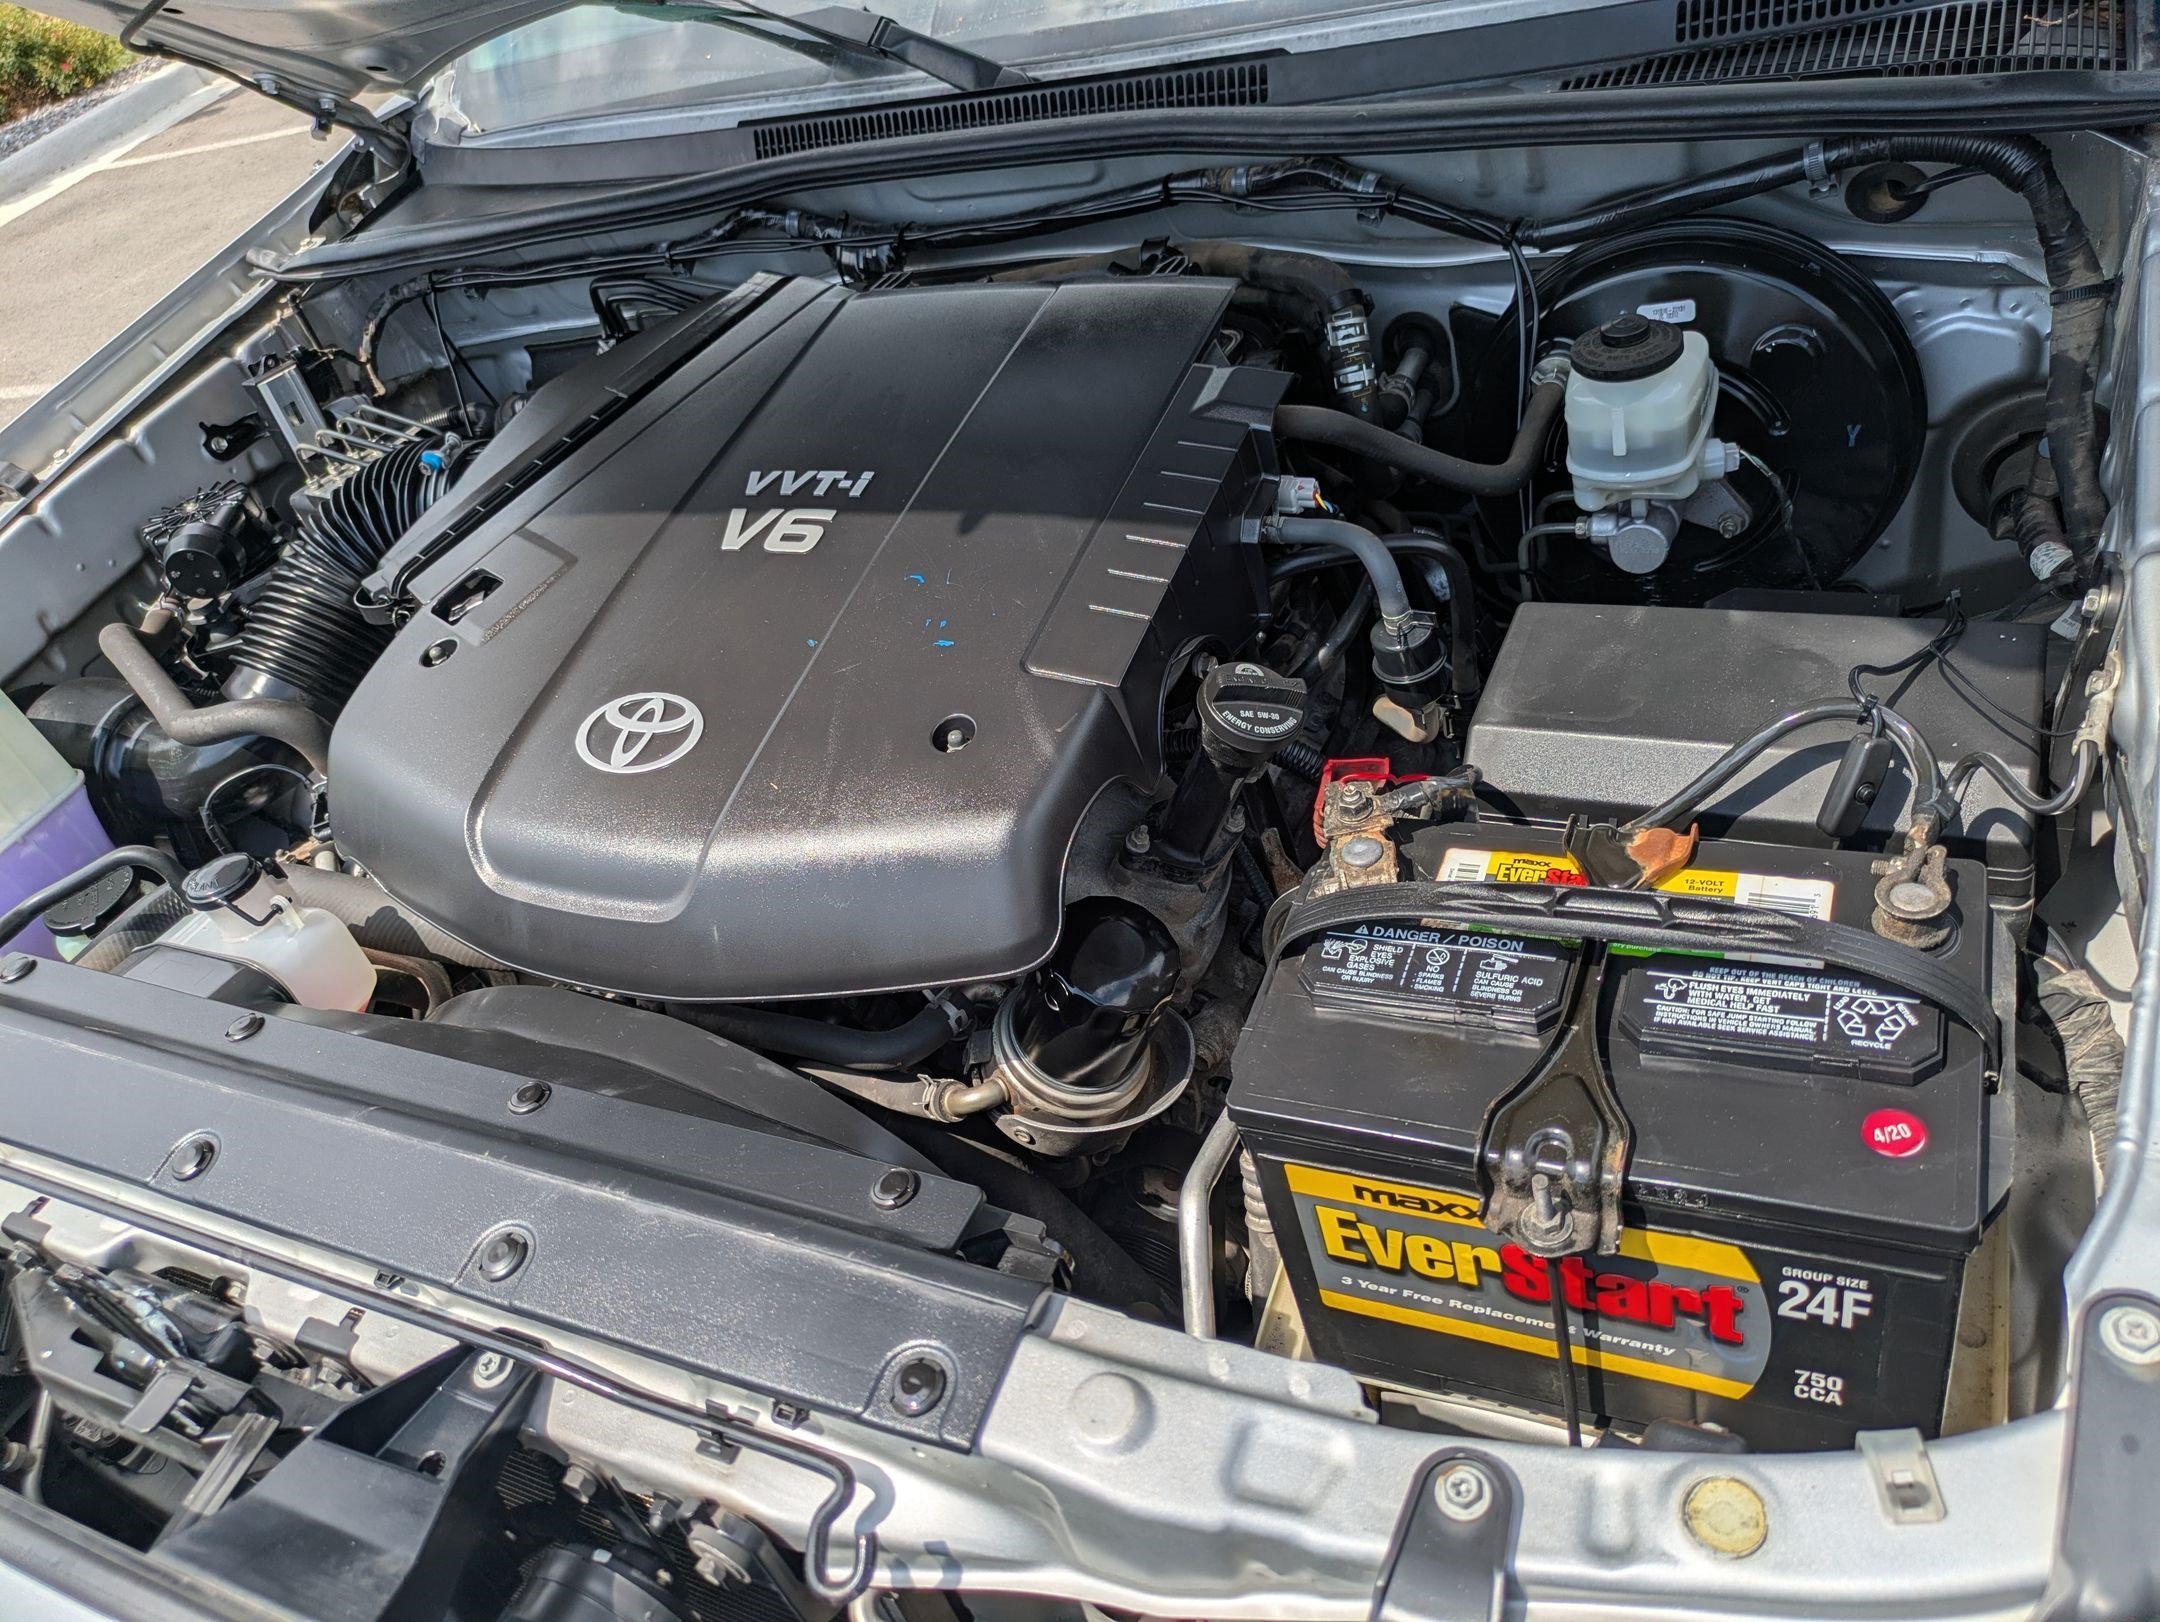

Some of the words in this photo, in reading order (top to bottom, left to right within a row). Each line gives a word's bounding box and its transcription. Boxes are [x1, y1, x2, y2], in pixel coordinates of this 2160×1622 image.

[745, 470, 875, 498] VVT-i
[721, 508, 837, 554] V6
[1222, 710, 1253, 731] ENERGY
[1254, 716, 1297, 735] CONSERVING
[1240, 710, 1254, 718] SAE
[1257, 711, 1280, 721] 5W-30
[1513, 859, 1552, 867] maxx
[1495, 863, 1589, 888] EverSta
[1684, 878, 1725, 887] 12-VOLT
[1688, 885, 1724, 894] Battery
[1372, 926, 1440, 943] DANGER
[1458, 935, 1524, 952] POISON
[1371, 951, 1393, 959] EYES
[1373, 944, 1404, 954] SHIELD
[1346, 962, 1375, 971] GASES
[1349, 955, 1396, 966] EXPLOSIVE
[1426, 965, 1440, 973] NO
[1337, 968, 1358, 976] CAUSE
[1359, 970, 1394, 980] BLINDNESS
[1352, 975, 1375, 984] INJURY
[1416, 978, 1442, 986] FLAMES
[1418, 972, 1445, 980] SPARKS
[1475, 971, 1519, 983] SULFURIC
[1521, 976, 1544, 986] ACID
[1692, 970, 1703, 978] DO
[1740, 976, 1761, 984] KEEP
[1762, 978, 1783, 986] VENT
[1783, 980, 1805, 989] CAPS
[1807, 983, 1831, 991] TIGHT
[1833, 985, 1851, 993] AND
[1761, 971, 1776, 979] THE
[1778, 973, 1804, 981] REACH
[1819, 977, 1861, 988] CHILDREN
[1413, 984, 1445, 993] SMOKING
[1470, 991, 1497, 1000] SEVERE
[1498, 994, 1521, 1002] BURNS
[1472, 985, 1510, 995] BLINDNESS
[1688, 981, 1719, 992] FLUSH
[1721, 985, 1744, 994] EYES
[1746, 987, 1811, 1002] IMMEDIATELY
[1688, 989, 1713, 999] WITH
[1753, 996, 1772, 1005] GET
[1687, 996, 1728, 1008] MEDICAL
[1729, 1001, 1755, 1010] HELP
[1756, 1004, 1780, 1014] FAST
[1655, 1010, 1707, 1022] INSTRUCTIONS
[1717, 1018, 1748, 1027] VEHICLE
[1662, 1017, 1676, 1025] NOT
[1677, 1019, 1716, 1030] AVAILABLE
[1717, 1024, 1736, 1032] SEEK
[1737, 1025, 1768, 1036] SERVICE
[1691, 1008, 1706, 1016] FOR
[1707, 1010, 1726, 1018] SAFE
[1726, 1012, 1748, 1020] JUMP
[1748, 1014, 1784, 1025] STARTING
[1786, 1019, 1817, 1028] FOLLOW
[1851, 1039, 1892, 1050] RECYCLE
[1873, 1122, 1912, 1144] 4/20
[1353, 1184, 1482, 1220] maxx
[1315, 1204, 1743, 1344] EverStart
[1782, 1265, 1833, 1284] GROUP
[1836, 1275, 1870, 1291] SIZE
[1777, 1280, 1873, 1330] 24F
[1340, 1276, 1353, 1286] 3
[1357, 1279, 1398, 1296] Year
[1402, 1289, 1443, 1305] Free
[1449, 1299, 1577, 1335] Replacemet
[1583, 1326, 1677, 1357] Warranty
[1794, 1369, 1844, 1392] 750
[1794, 1384, 1844, 1407] CCA
